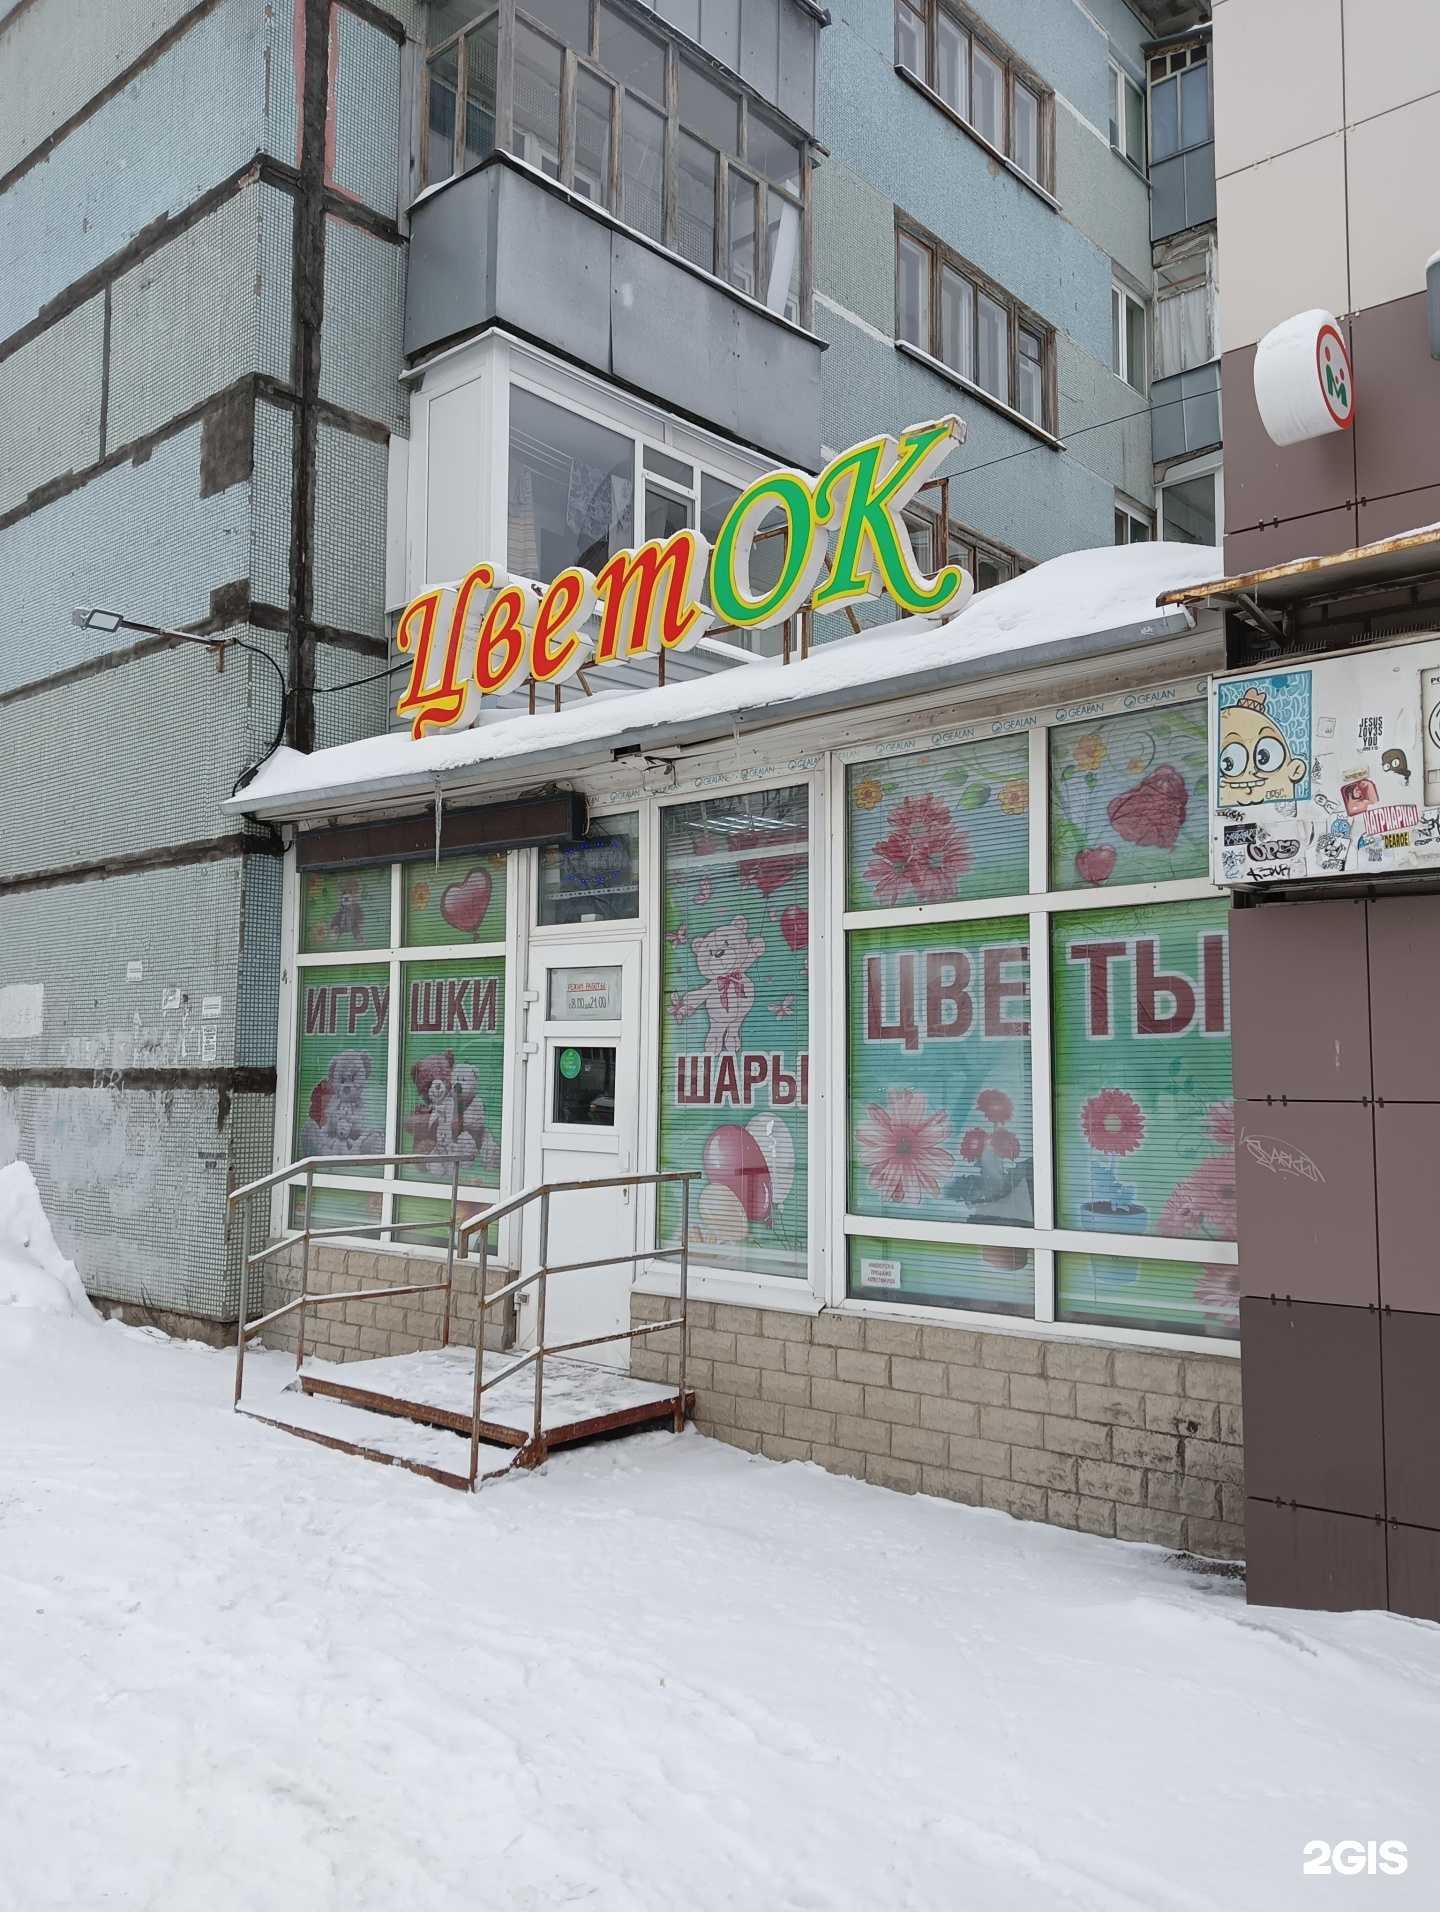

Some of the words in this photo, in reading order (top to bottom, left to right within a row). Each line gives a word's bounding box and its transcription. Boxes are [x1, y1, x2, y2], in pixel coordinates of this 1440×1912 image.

[396, 418, 973, 741] ЦветОК
[1137, 689, 1176, 705] GEALAN
[1003, 715, 1037, 730] GEALAN
[1359, 716, 1383, 728] JESUS
[942, 728, 975, 742] GEALAN
[1363, 736, 1378, 747] YOU
[885, 740, 916, 753] GEALAN
[676, 1053, 808, 1106] ШАРЫ
